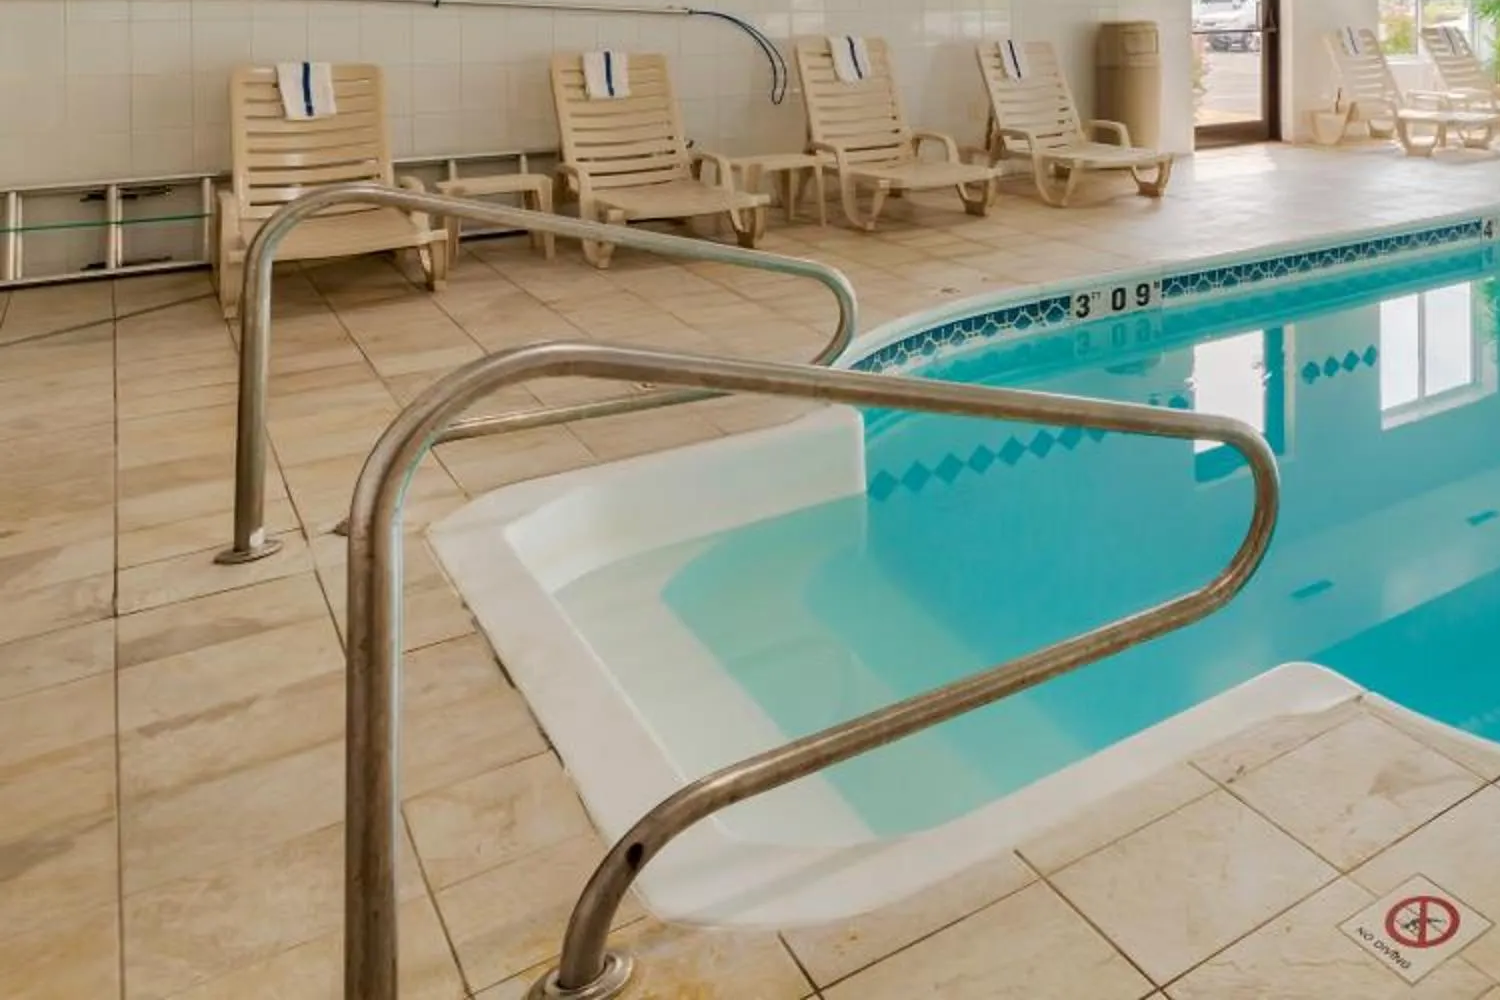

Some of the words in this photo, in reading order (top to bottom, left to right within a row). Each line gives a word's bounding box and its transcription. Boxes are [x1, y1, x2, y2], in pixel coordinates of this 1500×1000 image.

[1483, 219, 1493, 239] 4
[1075, 293, 1091, 318] 3
[1356, 926, 1375, 941] NO
[1373, 939, 1412, 969] DIVING
